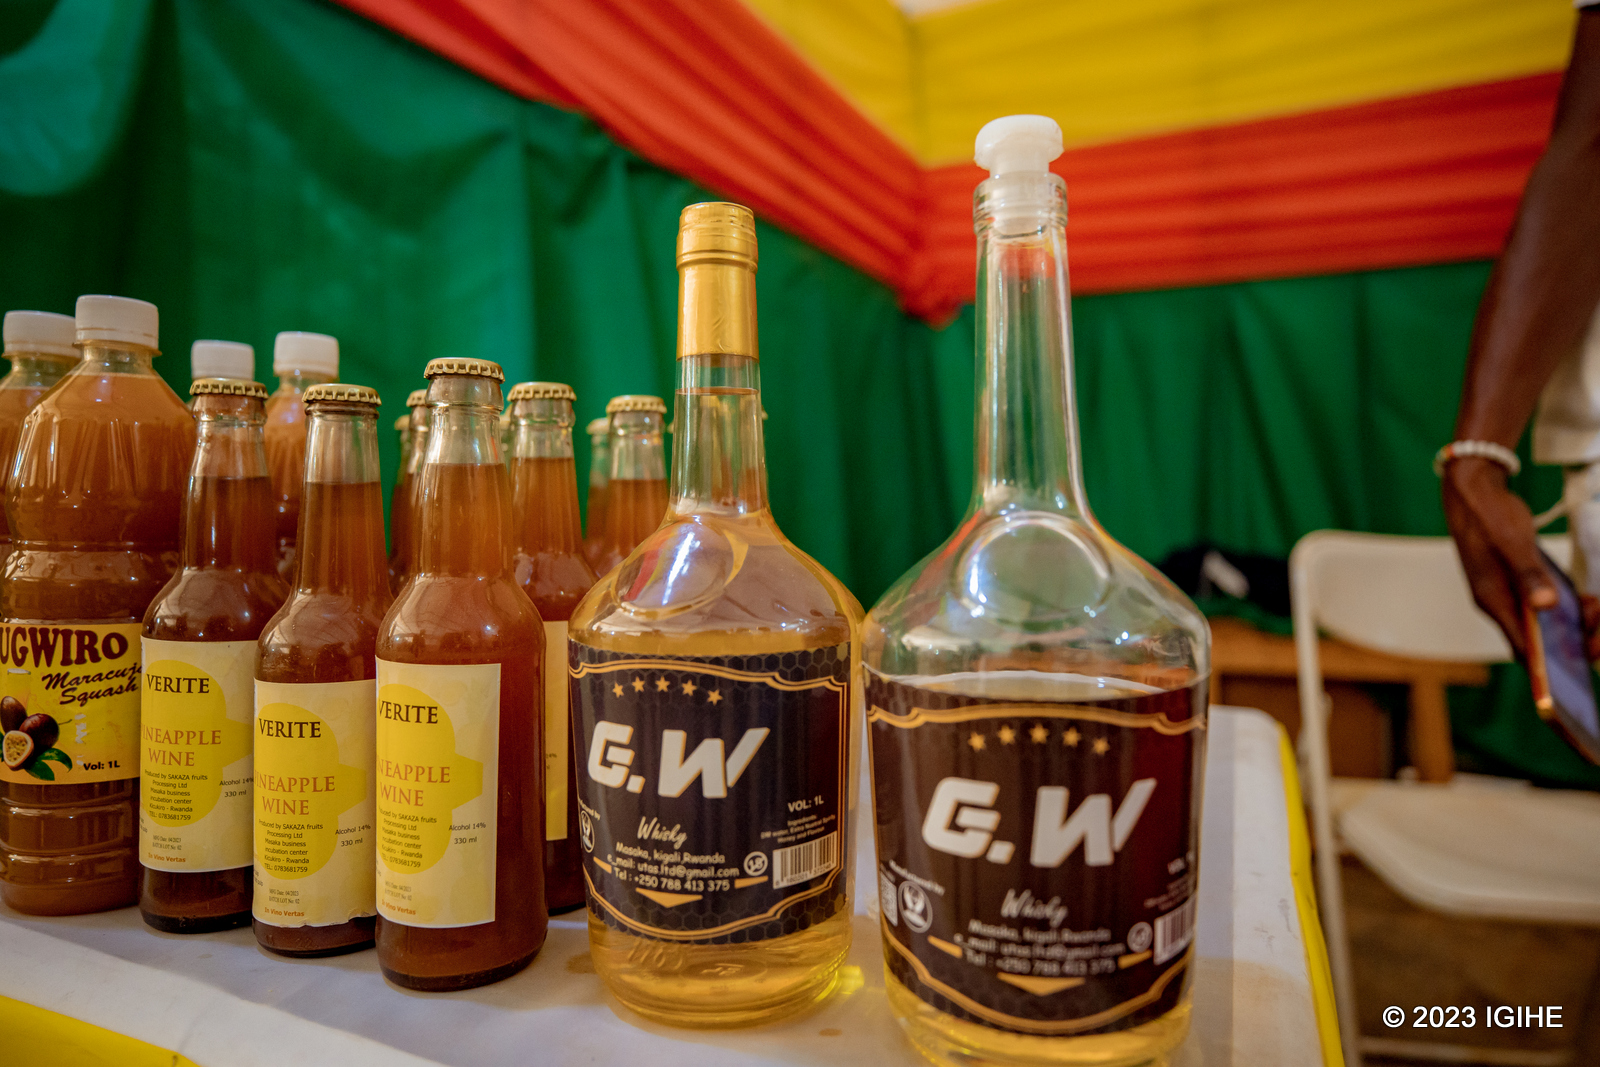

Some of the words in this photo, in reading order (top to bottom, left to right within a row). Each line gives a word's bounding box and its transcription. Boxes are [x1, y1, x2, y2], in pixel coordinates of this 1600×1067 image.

[0, 627, 128, 668] UGWIRO
[146, 674, 209, 693] VERITE
[59, 677, 139, 707] Squash
[258, 718, 321, 738] VERITE
[148, 747, 195, 767] WINE
[587, 720, 771, 799] G.W
[83, 761, 105, 771] Vol:
[107, 760, 121, 769] 1L
[152, 779, 177, 789] Processing
[178, 780, 188, 788] Ltd
[219, 778, 241, 786] Alcohol
[150, 787, 166, 795] Masaka
[166, 788, 191, 796] business
[380, 781, 424, 807] WINE
[262, 796, 309, 815] WINE
[788, 799, 812, 813] VOL:
[814, 795, 824, 806] 1L
[398, 813, 419, 822] SAKAZA
[420, 816, 437, 824] fruits
[921, 776, 1157, 868] G.W
[335, 827, 356, 835] Alcohol
[358, 824, 371, 832] 14%
[449, 823, 470, 831] Alcohol
[637, 816, 687, 850] Whisky
[267, 830, 292, 839] Processing
[397, 832, 420, 840] business
[265, 838, 281, 846] Masaka
[401, 850, 422, 858] Rwanda
[616, 842, 651, 861] Masaka,
[389, 856, 421, 868] 0783681759
[635, 873, 658, 888] +250
[660, 877, 681, 891] 788
[684, 879, 704, 892] 413
[707, 880, 730, 892] 375
[271, 908, 282, 916] Vino
[386, 902, 396, 911] Vino
[397, 904, 416, 915] Vertas
